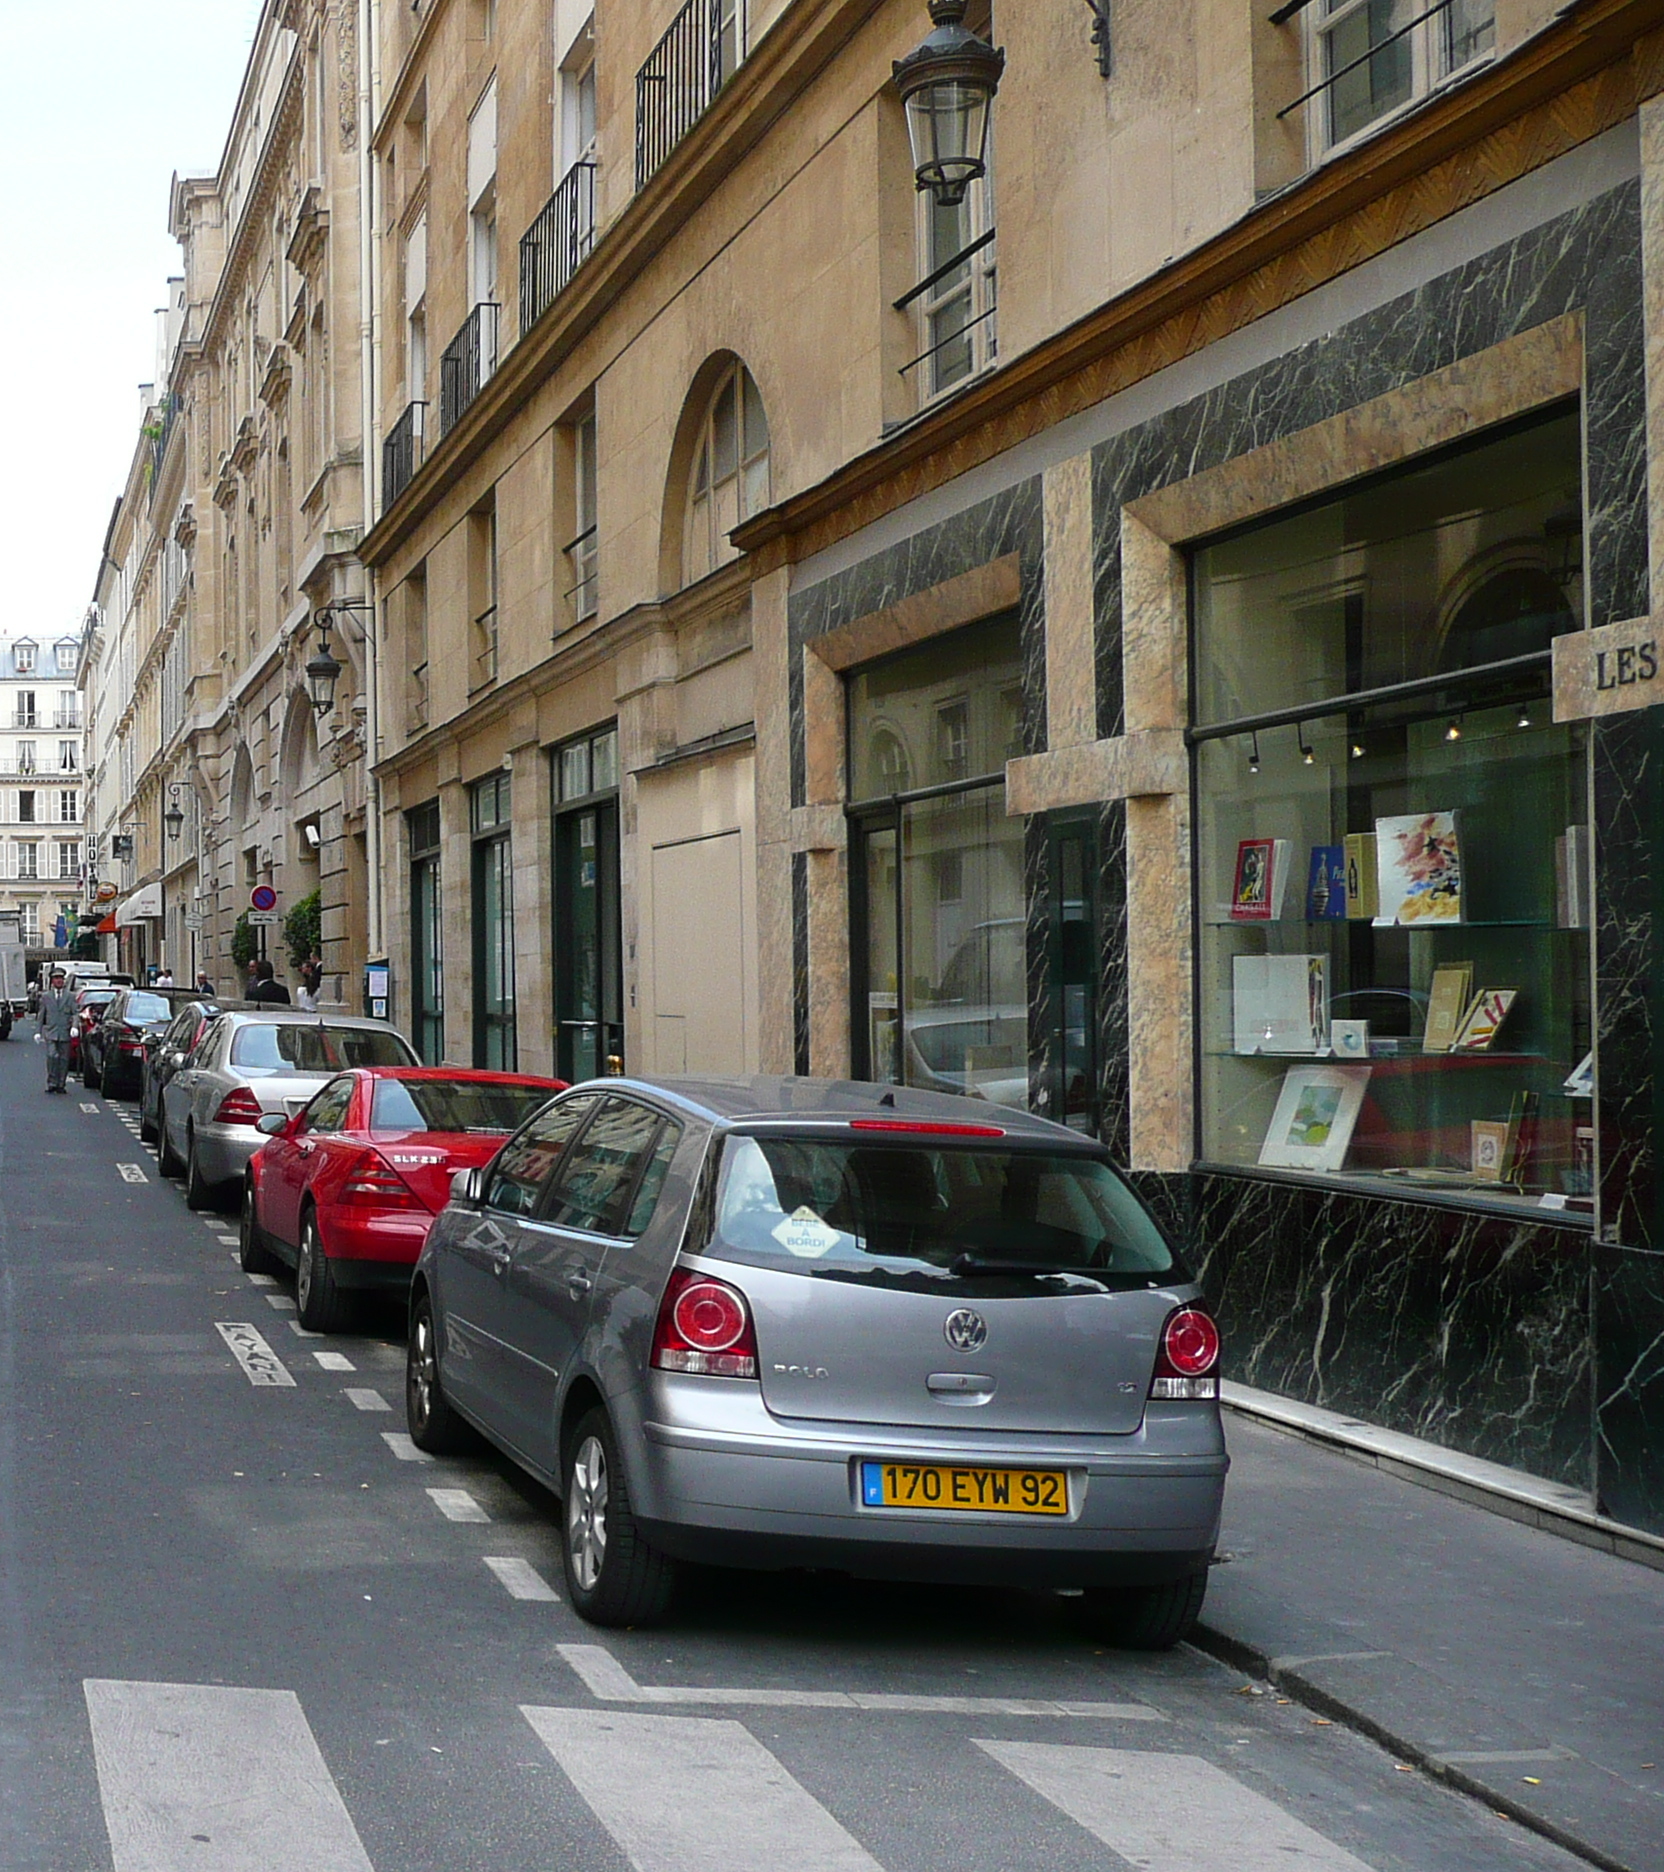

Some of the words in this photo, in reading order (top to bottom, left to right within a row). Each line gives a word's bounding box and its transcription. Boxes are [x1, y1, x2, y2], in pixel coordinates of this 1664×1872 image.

[1596, 640, 1657, 690] LES
[88, 835, 97, 900] HOTL
[393, 1154, 418, 1164] SLK
[773, 1363, 829, 1379] POLO
[886, 1466, 942, 1501] 170
[951, 1470, 1010, 1505] EYW
[1020, 1474, 1061, 1508] 92
